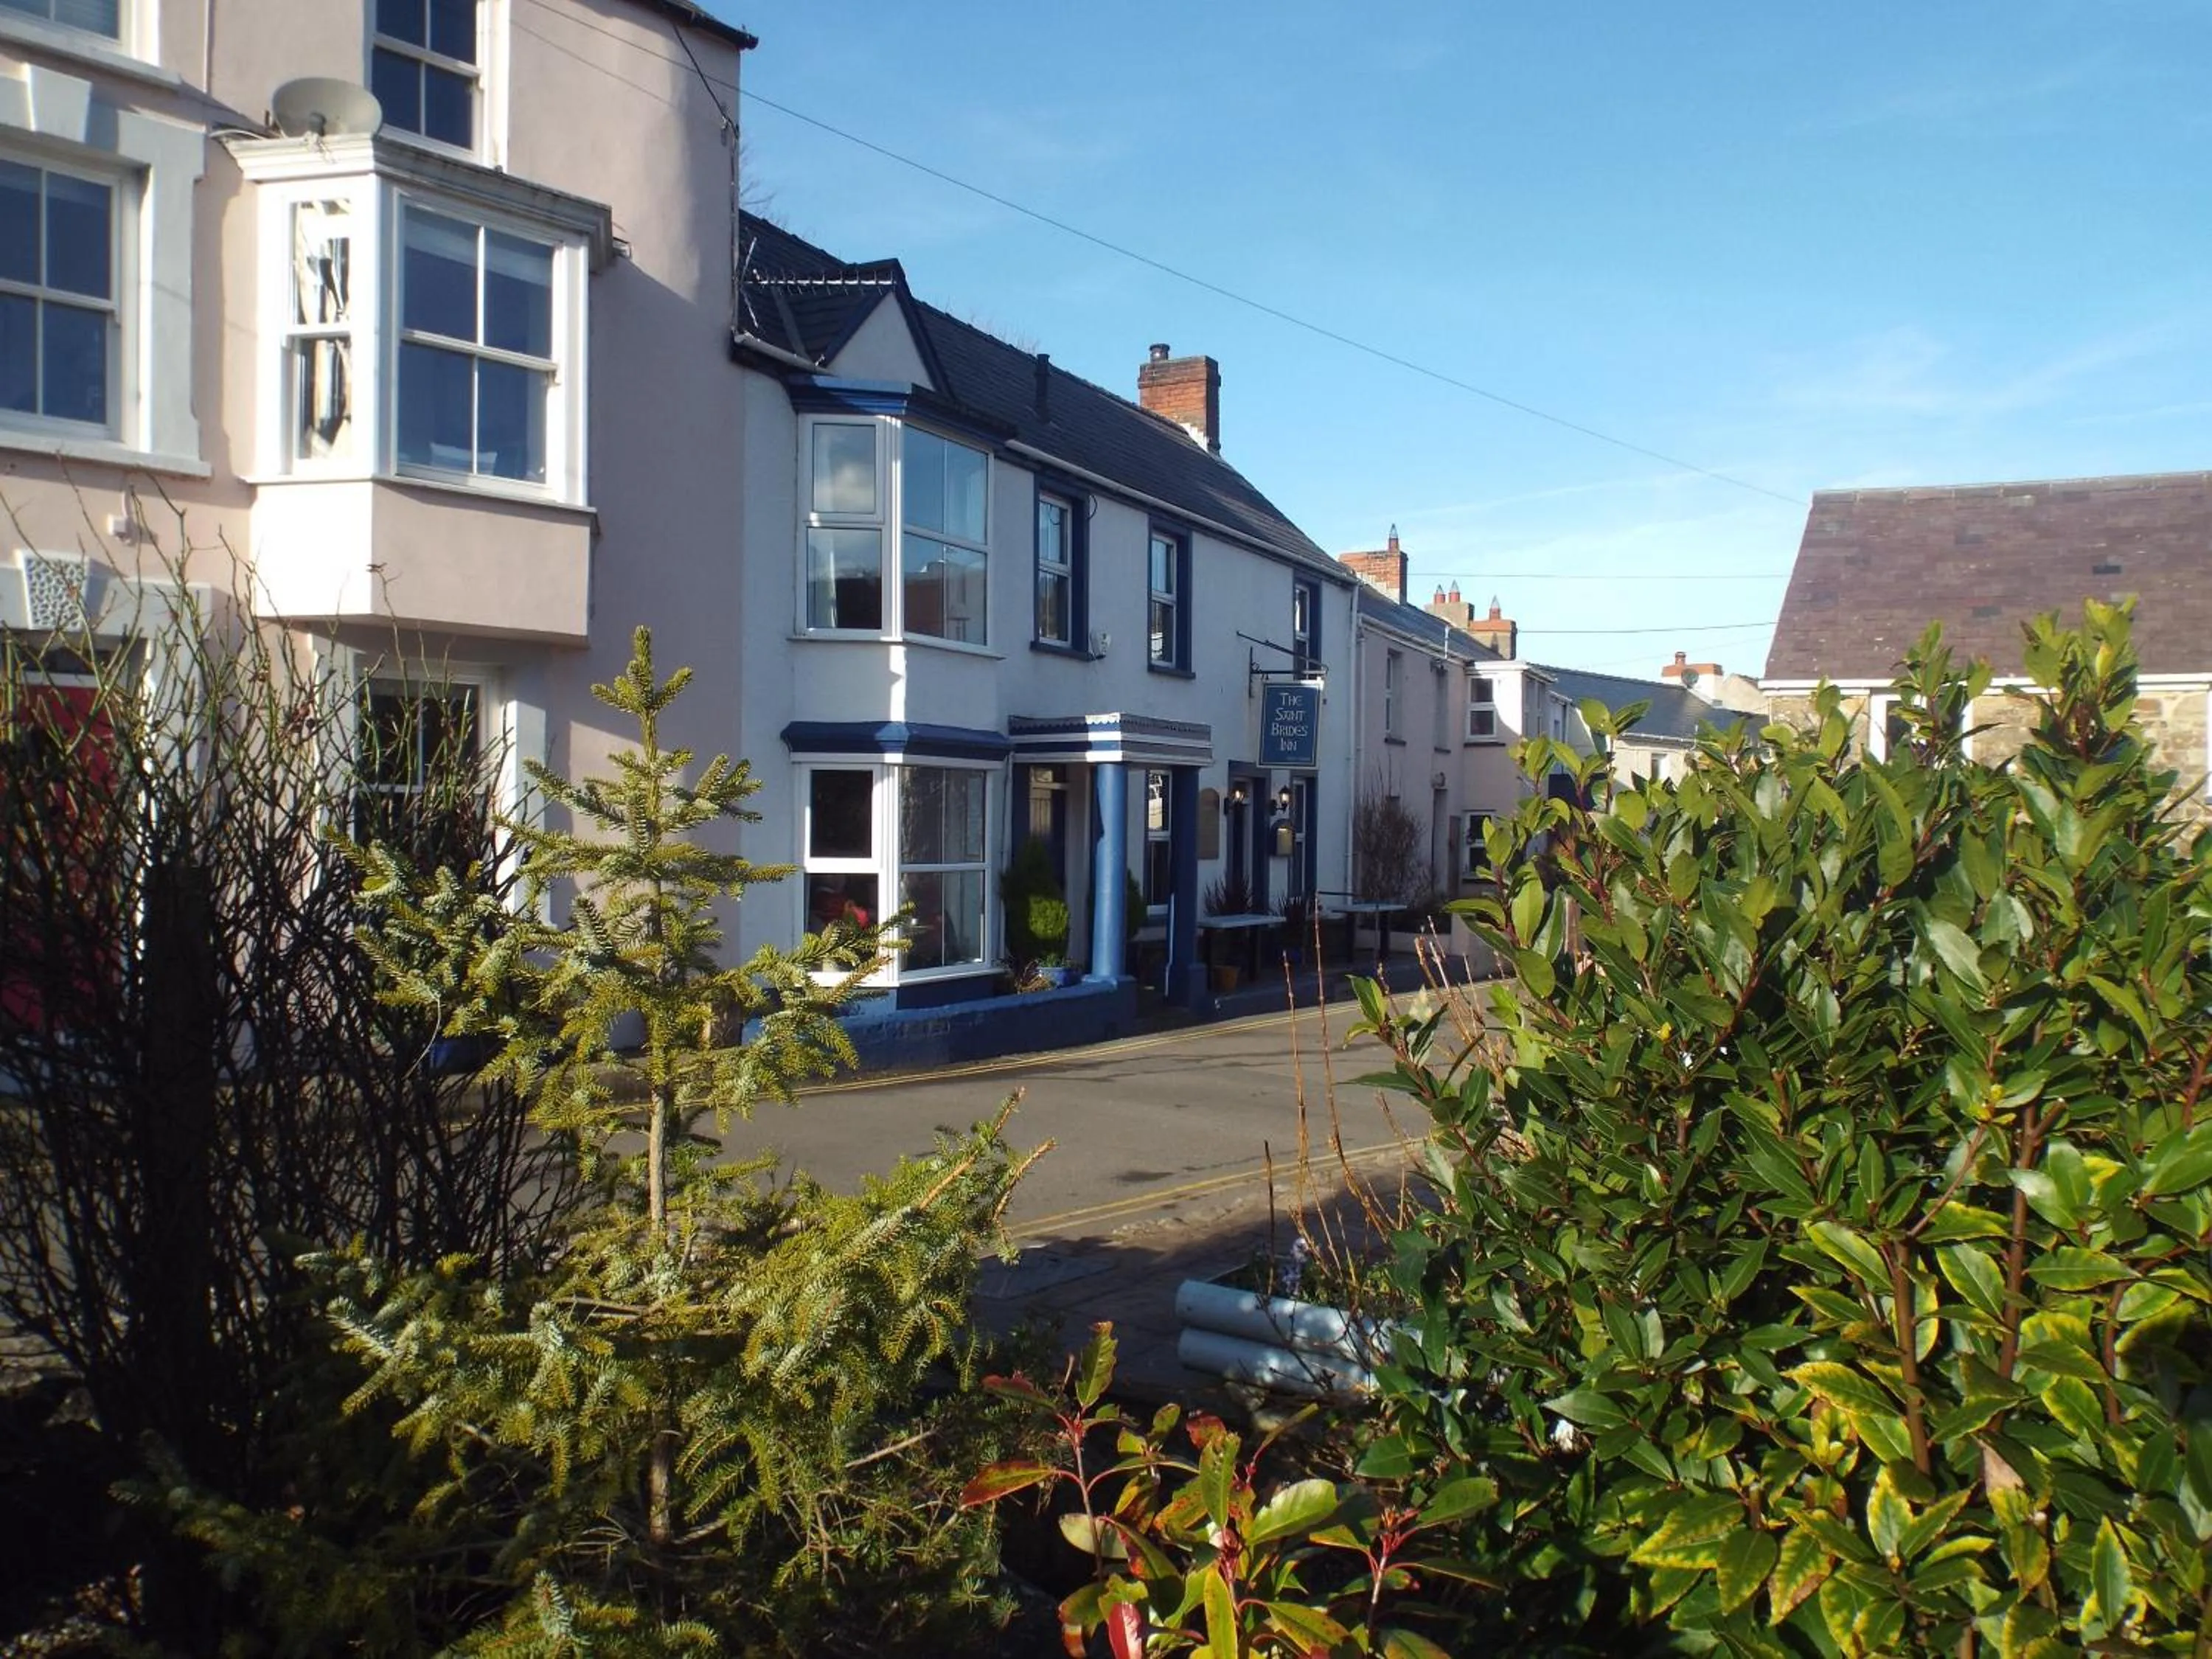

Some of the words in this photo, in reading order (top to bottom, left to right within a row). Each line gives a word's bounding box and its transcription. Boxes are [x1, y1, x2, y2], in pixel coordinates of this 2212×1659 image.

[1280, 692, 1304, 706] THE
[1275, 707, 1306, 721] SAINT
[1271, 723, 1308, 737] BRIDES
